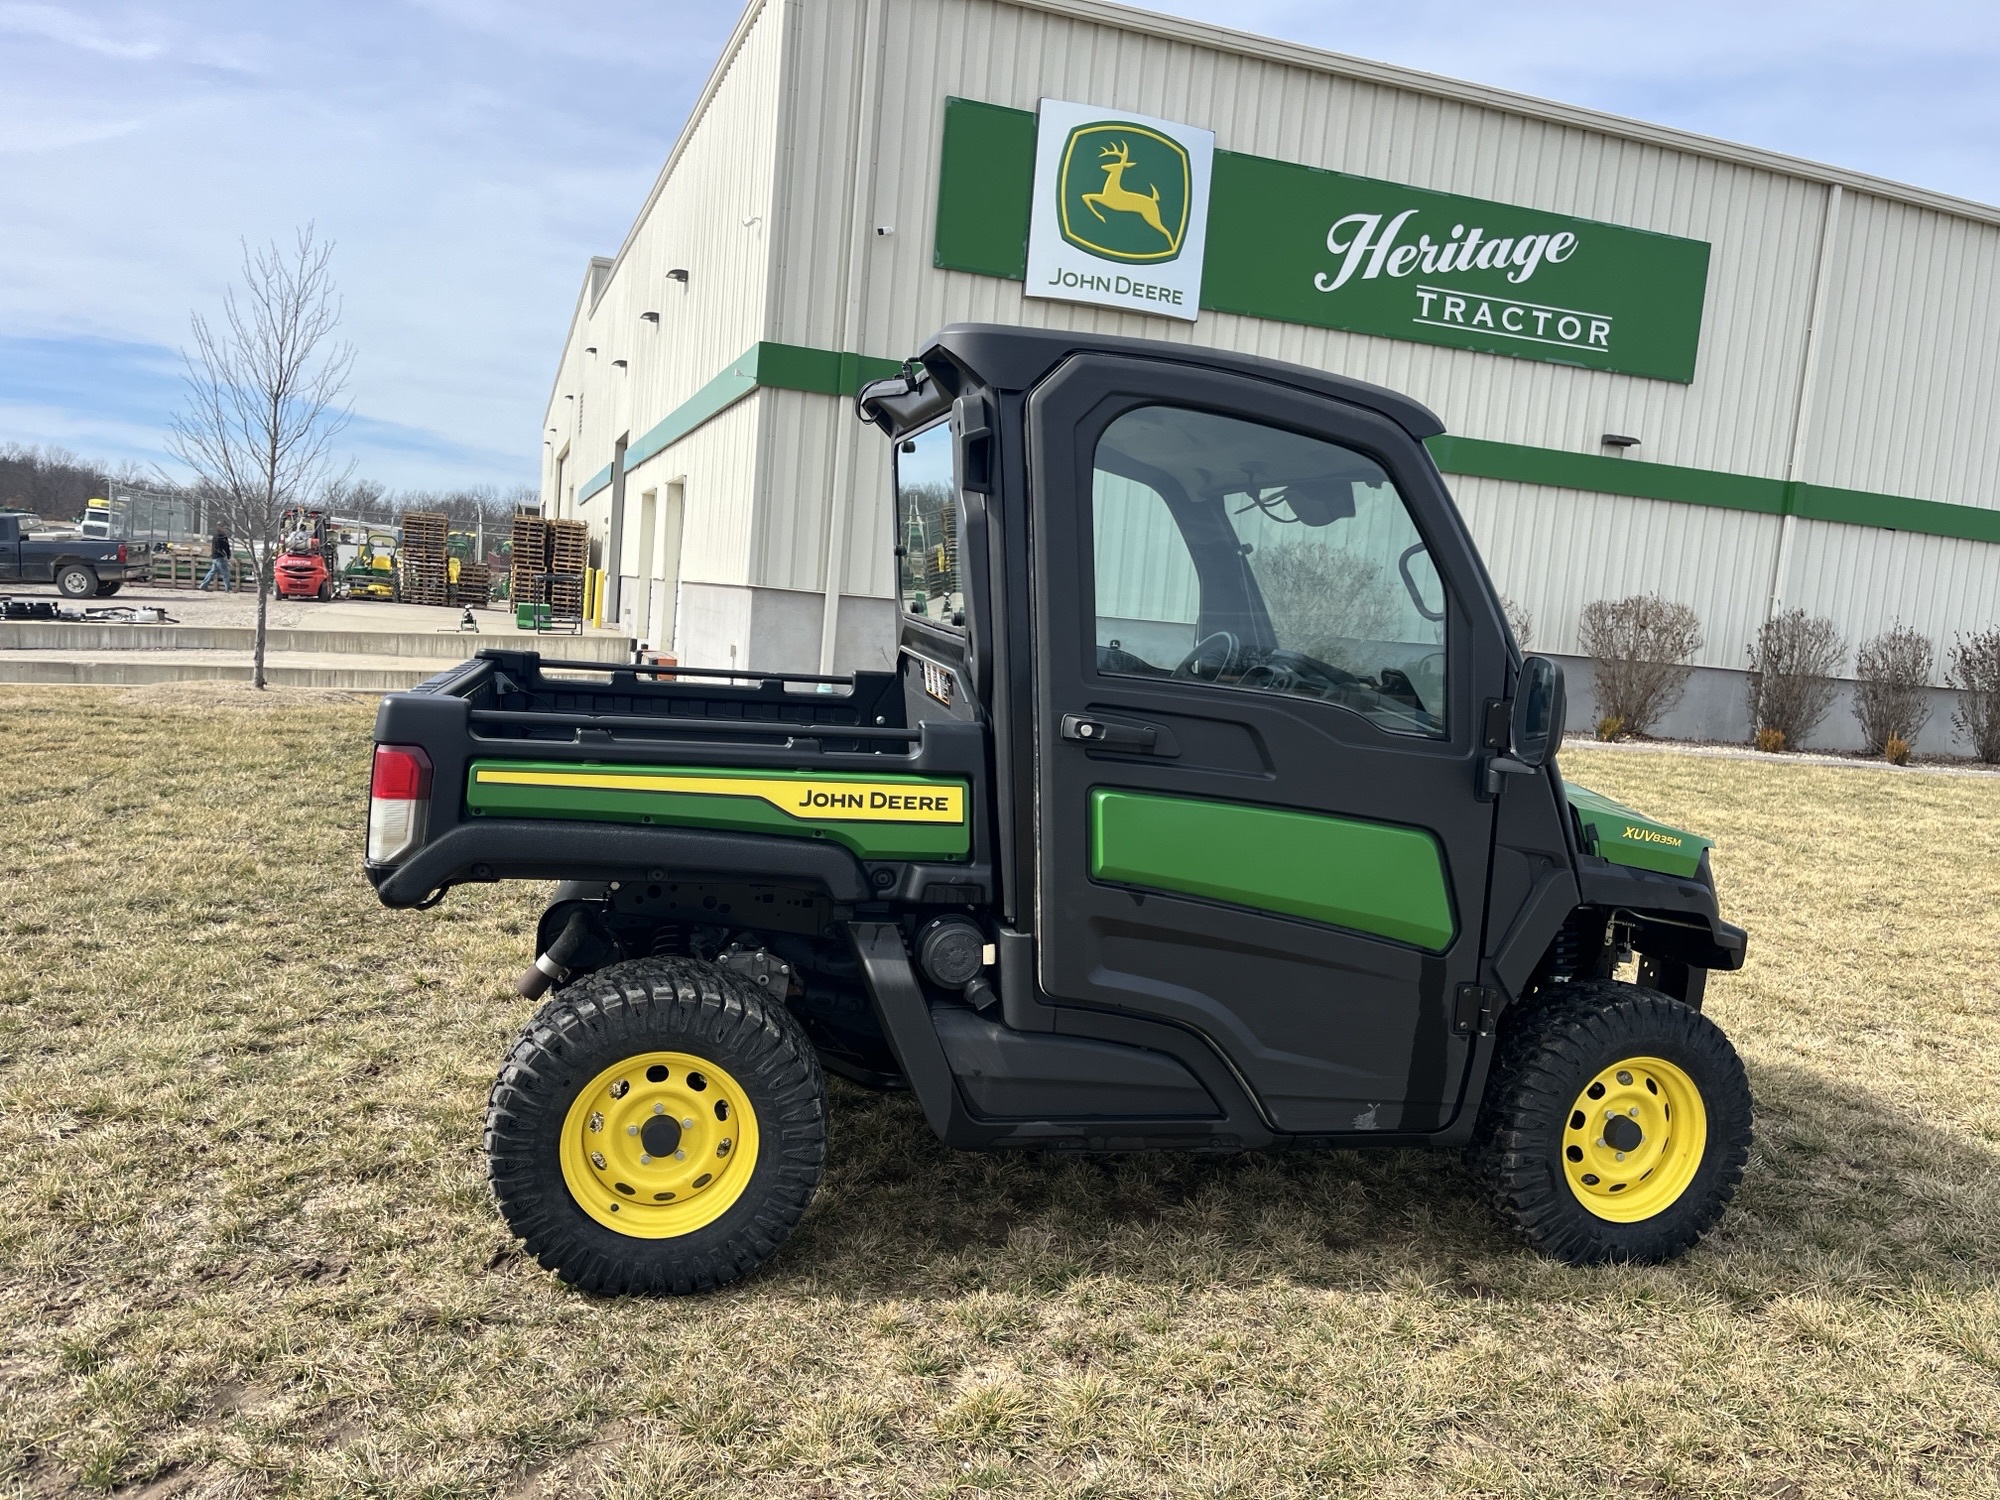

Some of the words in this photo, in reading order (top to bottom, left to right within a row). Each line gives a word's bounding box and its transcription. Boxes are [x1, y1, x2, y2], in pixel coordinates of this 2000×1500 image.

[1313, 209, 1579, 293] Heritage
[1048, 267, 1111, 293] JOHN
[1114, 275, 1184, 306] DEERE
[1415, 290, 1611, 346] TRACTOR
[799, 789, 864, 809] JOHN
[869, 791, 949, 812] DEERE
[1622, 826, 1682, 848] XUV835M
